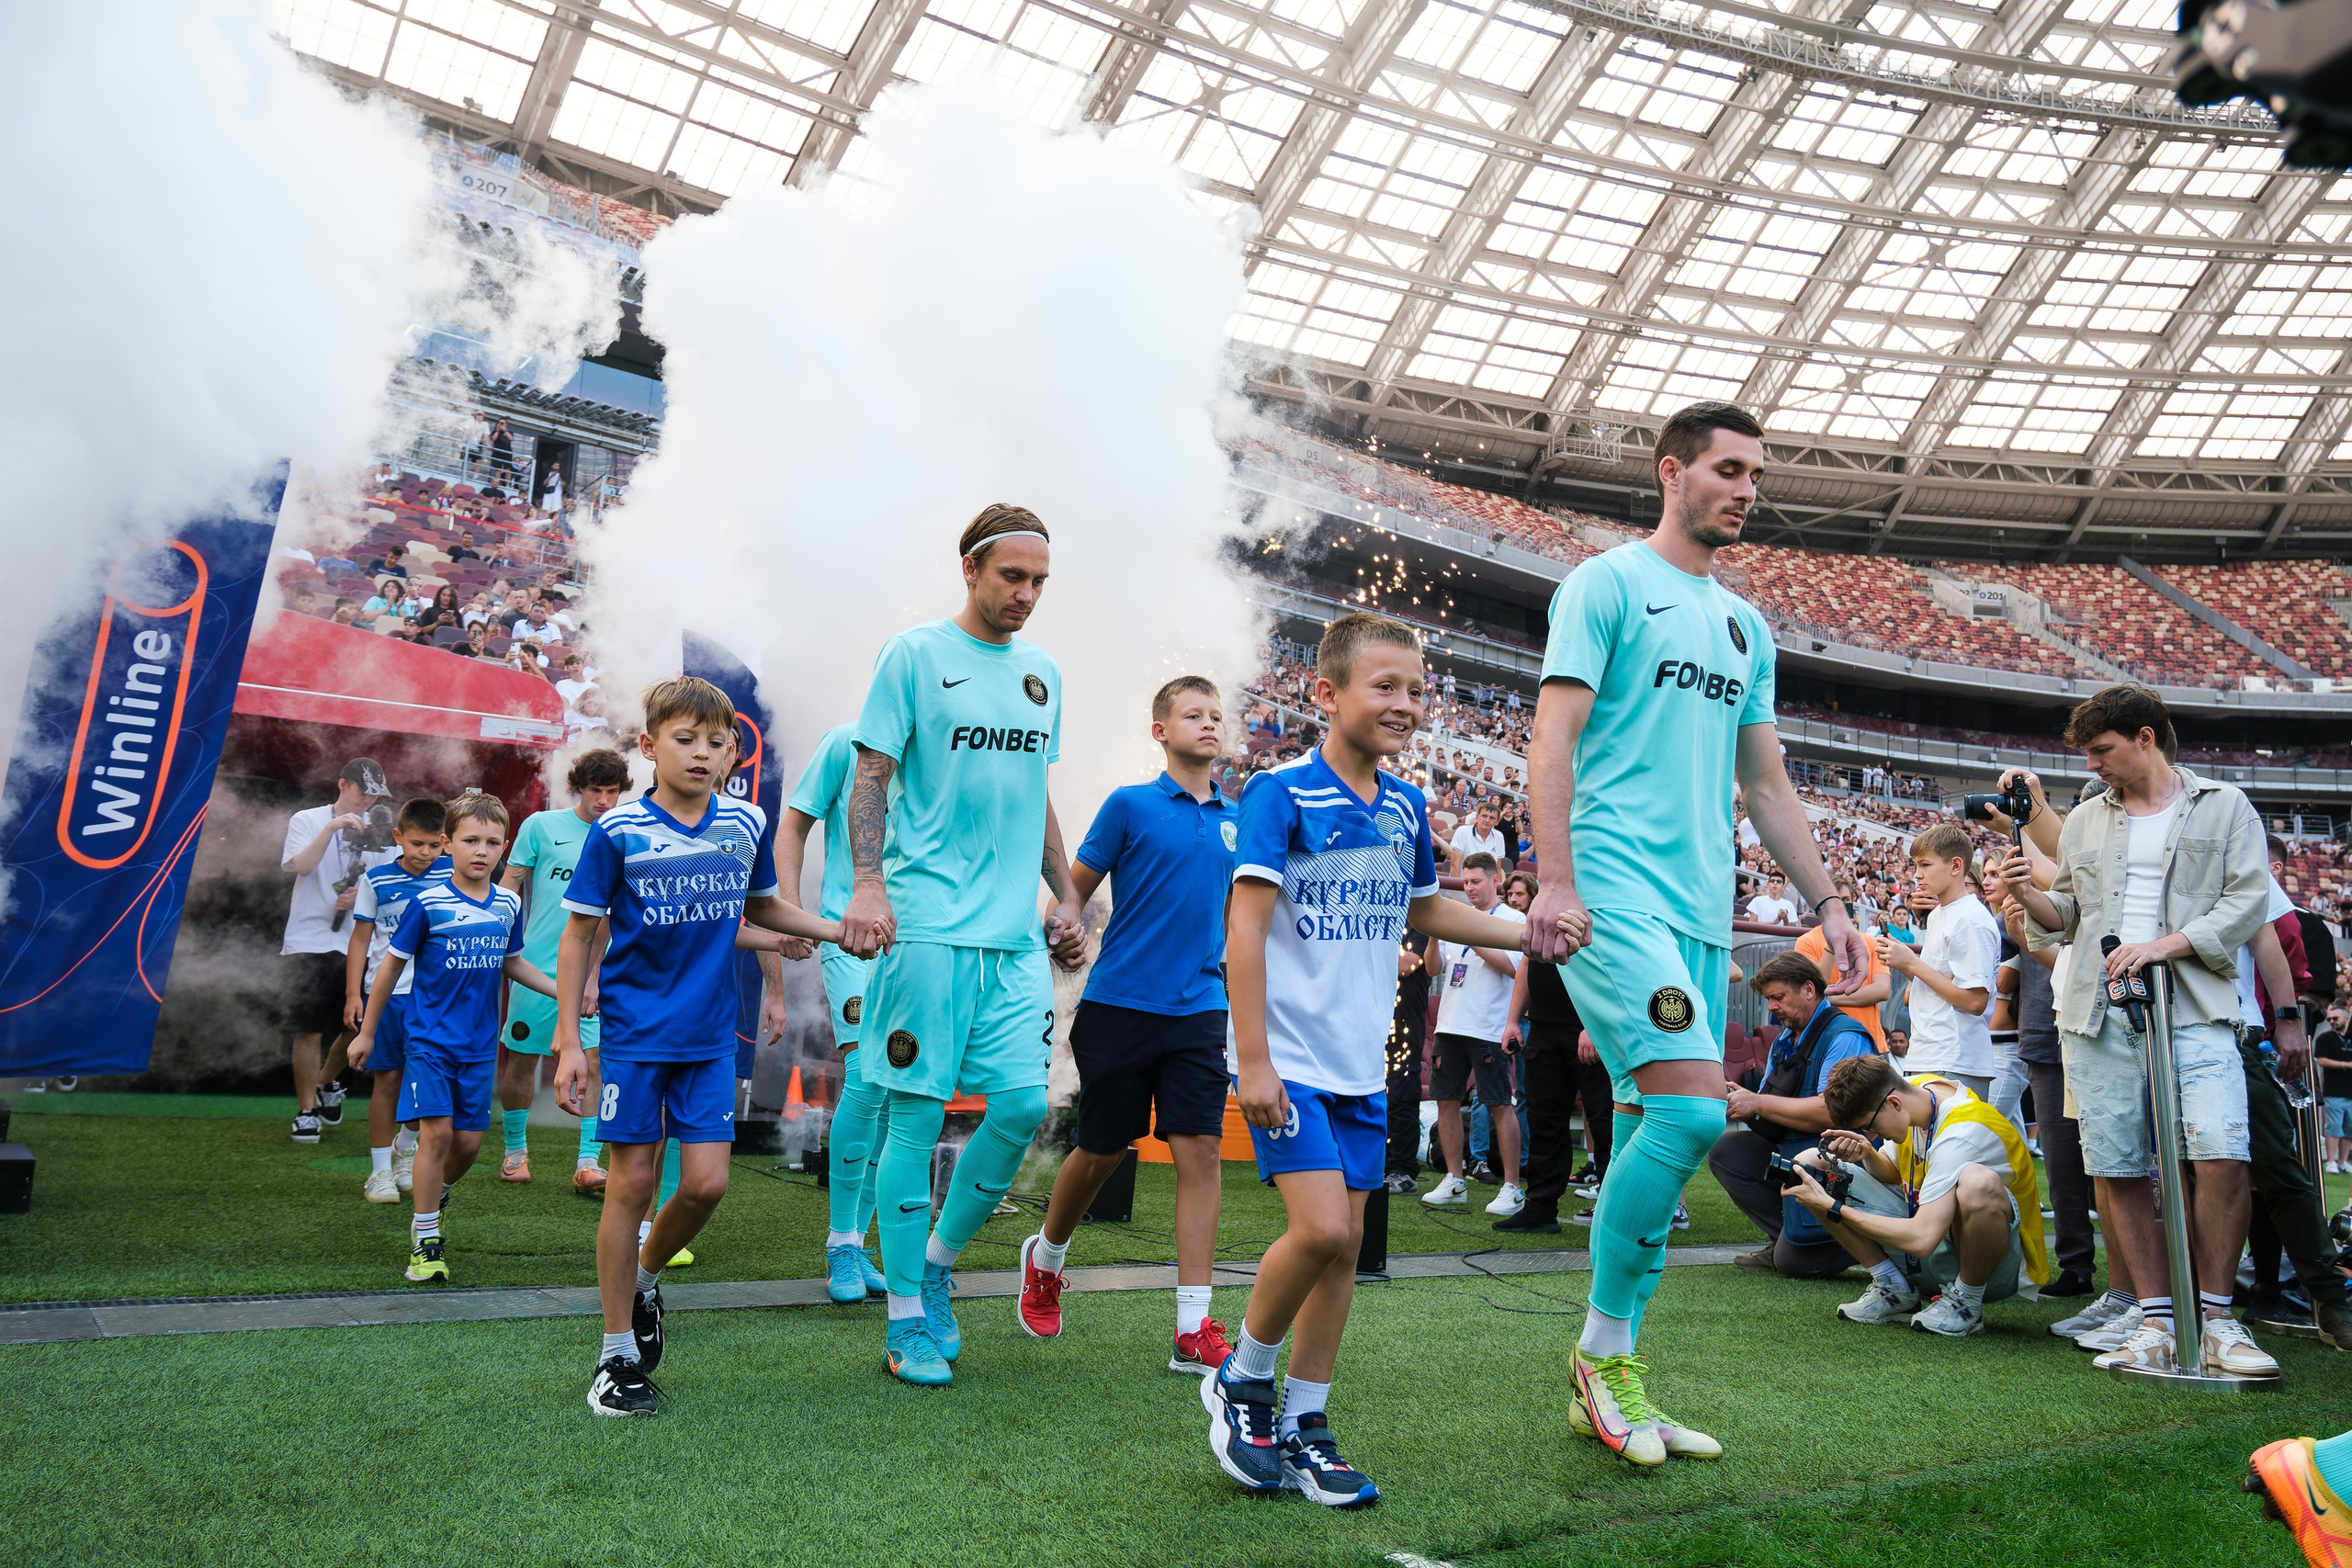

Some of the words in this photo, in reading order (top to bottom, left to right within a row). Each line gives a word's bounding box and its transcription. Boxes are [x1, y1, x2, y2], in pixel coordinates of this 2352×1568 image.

[477, 178, 507, 197] 207
[82, 629, 172, 836] Winline
[951, 726, 1049, 754] FONBET
[638, 870, 750, 902] КУРСКАЯ
[643, 898, 745, 927] ОБЛАСТ
[1296, 914, 1397, 941] ОБЛАСТ
[446, 954, 503, 970] ОБЛАСТ
[1662, 988, 1686, 999] DROTS
[600, 1083, 620, 1122] 8
